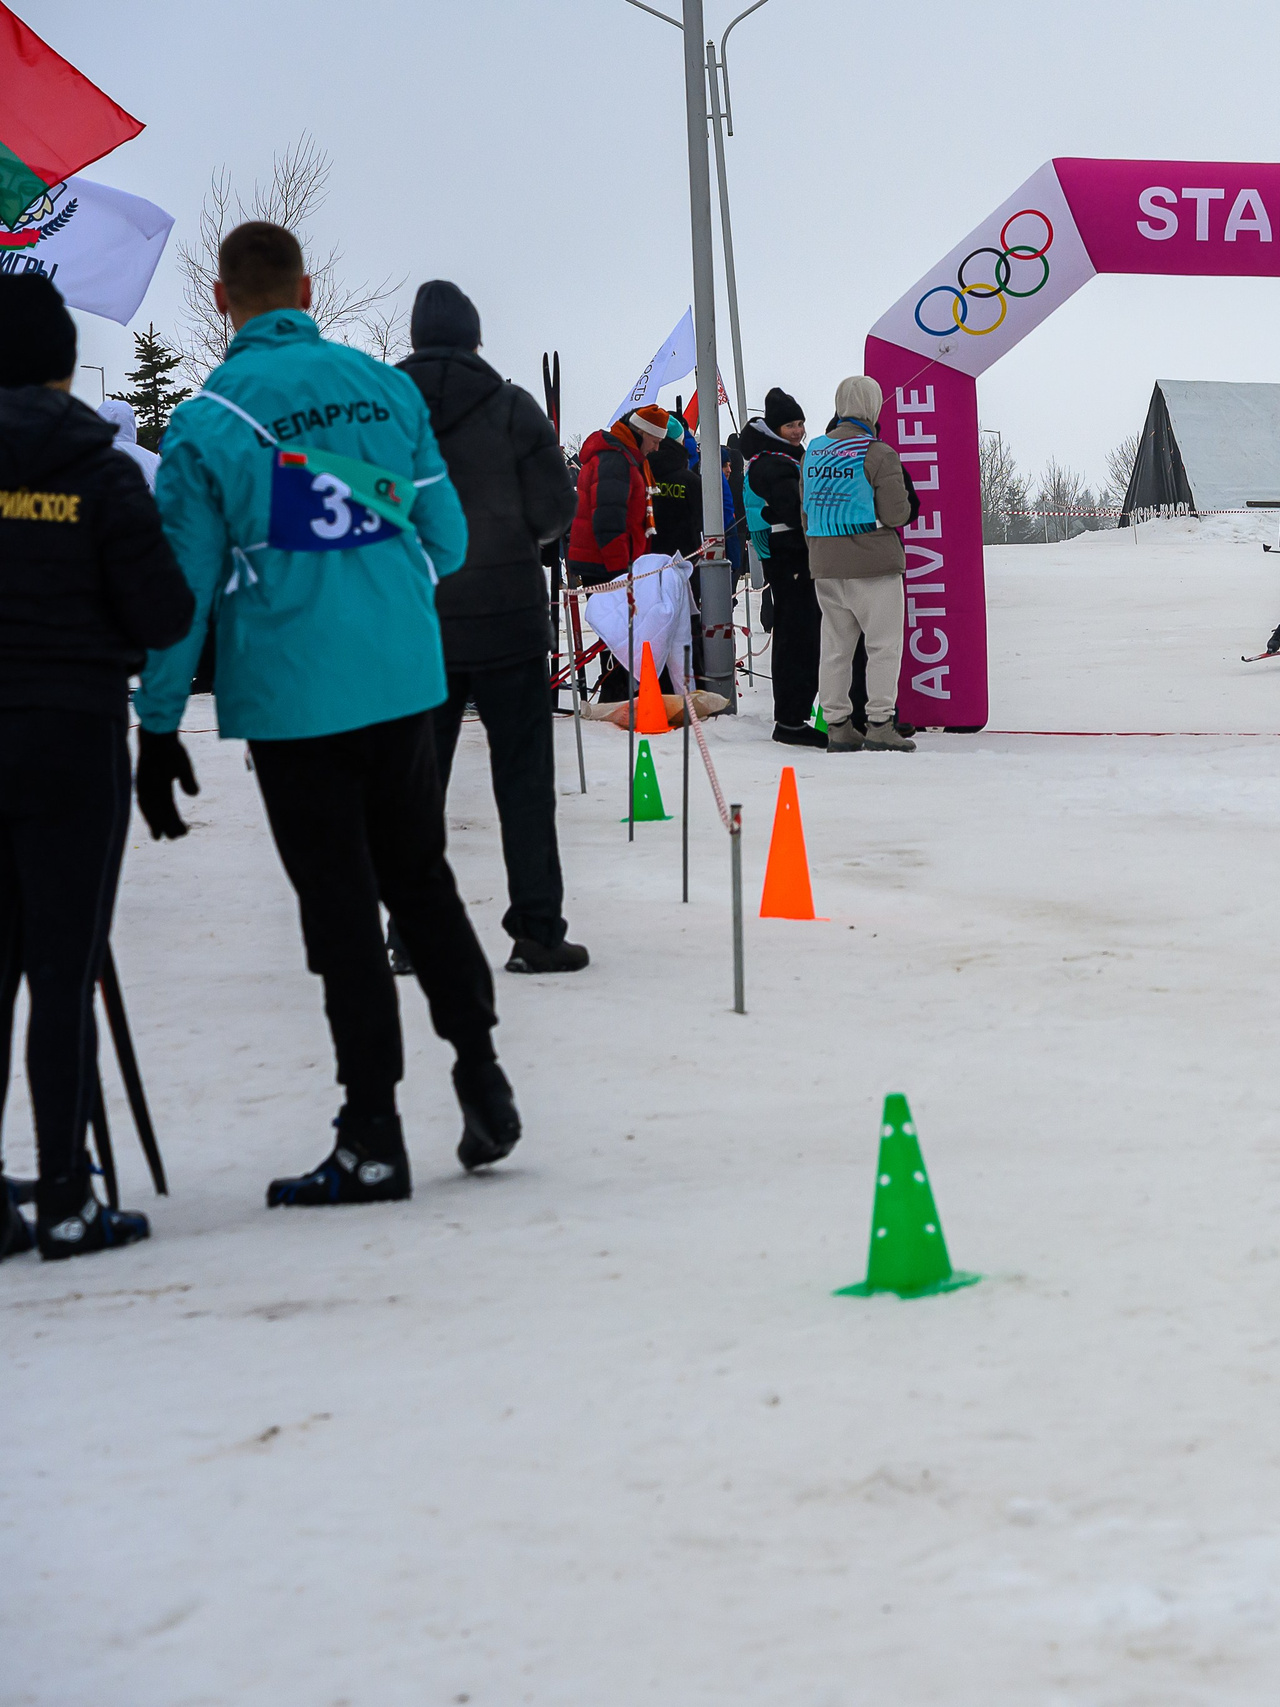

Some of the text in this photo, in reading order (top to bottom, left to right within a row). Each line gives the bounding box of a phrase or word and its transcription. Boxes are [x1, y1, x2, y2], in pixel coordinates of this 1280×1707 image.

[254, 401, 390, 449] БЕЛАРУСЬ
[807, 466, 854, 480] СУДЬЯ
[895, 385, 951, 700] ACTIVE LIFE
